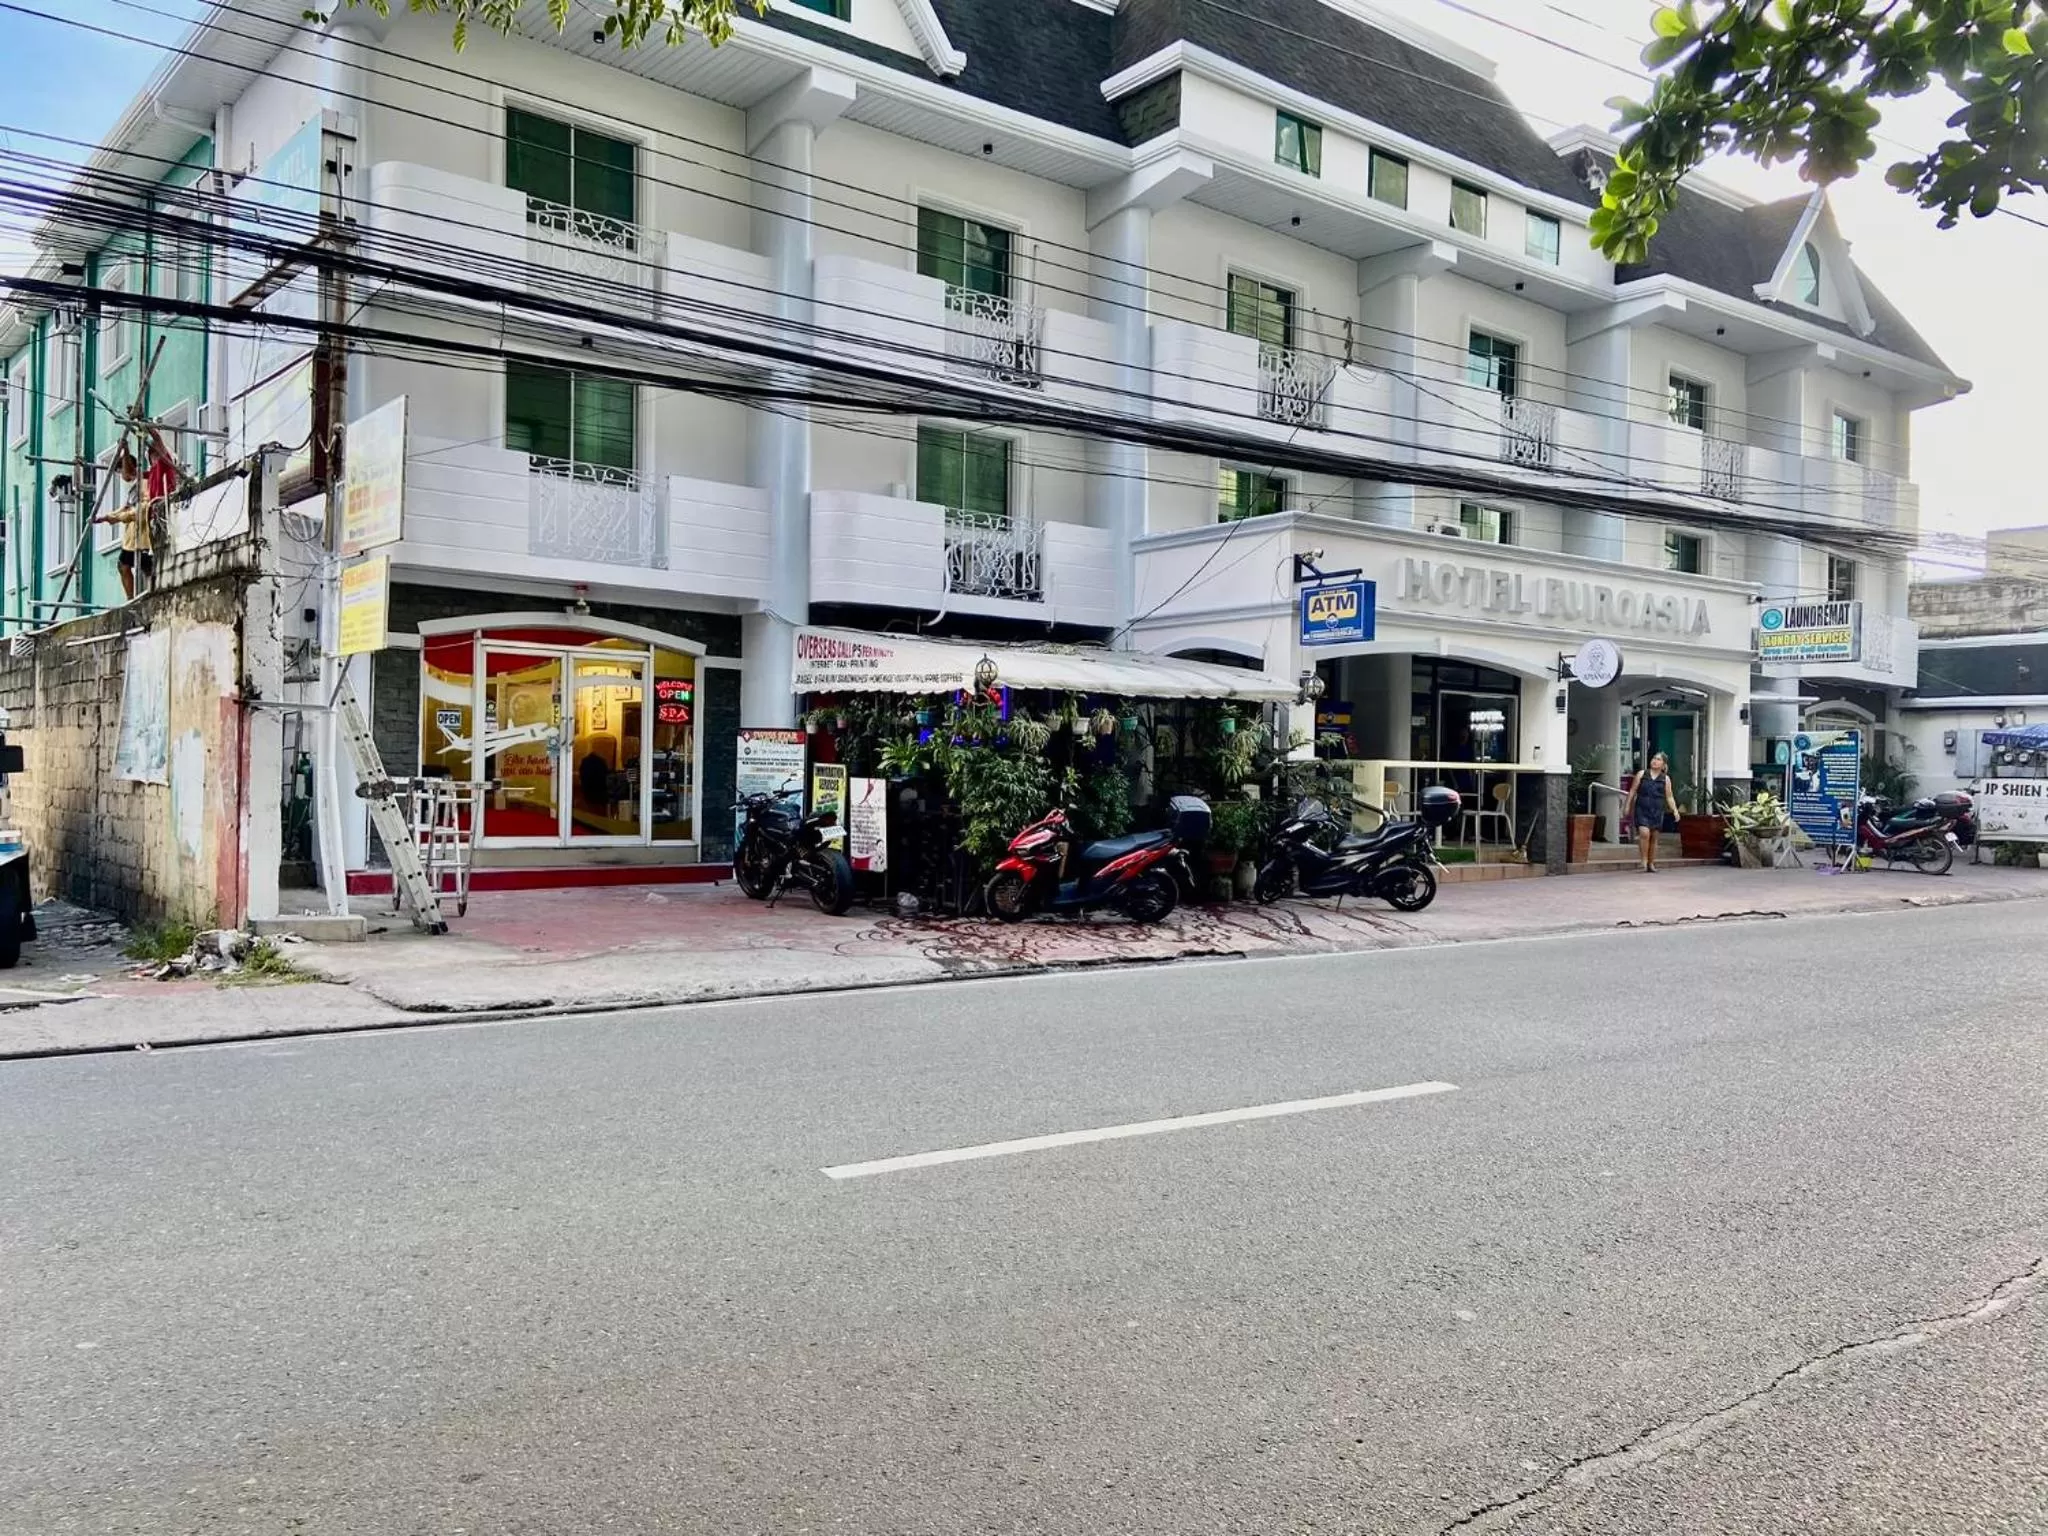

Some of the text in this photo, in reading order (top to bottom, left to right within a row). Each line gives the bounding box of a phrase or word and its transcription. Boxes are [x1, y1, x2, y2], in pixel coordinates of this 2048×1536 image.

[1311, 593, 1354, 614] ATM
[1397, 557, 1712, 637] HOTEL EUROASIA
[1784, 603, 1850, 628] LAUNDREMAT
[1803, 630, 1850, 644] SERVICES
[797, 634, 836, 659] OVERSEAS
[837, 641, 851, 658] CALL
[655, 681, 692, 691] WELCOME
[659, 689, 689, 700] OPEN
[438, 714, 461, 724] OPEN
[660, 708, 689, 719] SPA
[1470, 710, 1505, 722] HOTEL
[780, 731, 799, 741] STAR
[1984, 783, 2042, 798] JP SHIEN
